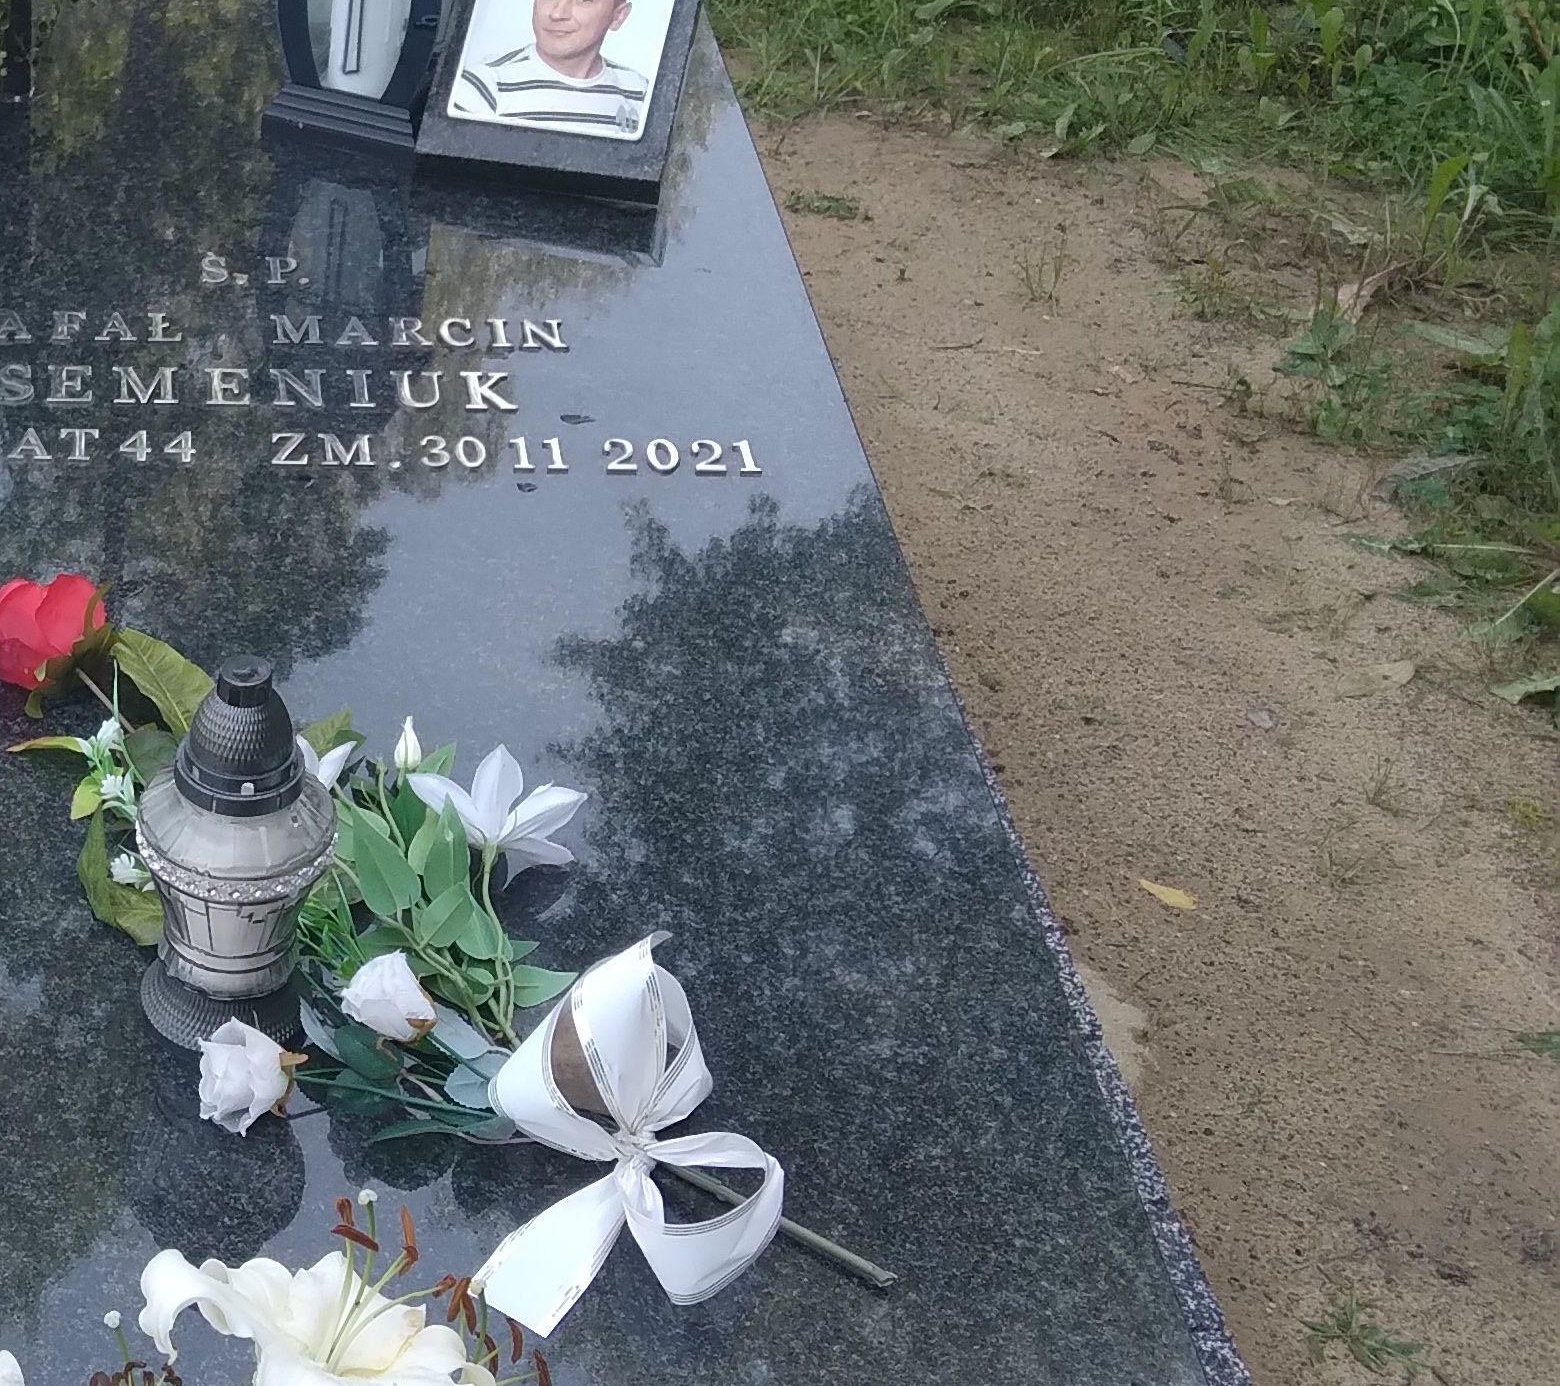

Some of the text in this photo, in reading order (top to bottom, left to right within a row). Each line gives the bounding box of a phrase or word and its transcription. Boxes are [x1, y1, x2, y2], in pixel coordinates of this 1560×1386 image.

[270, 314, 570, 352] MARCIN
[119, 428, 197, 463] 44
[602, 437, 763, 475] 2021
